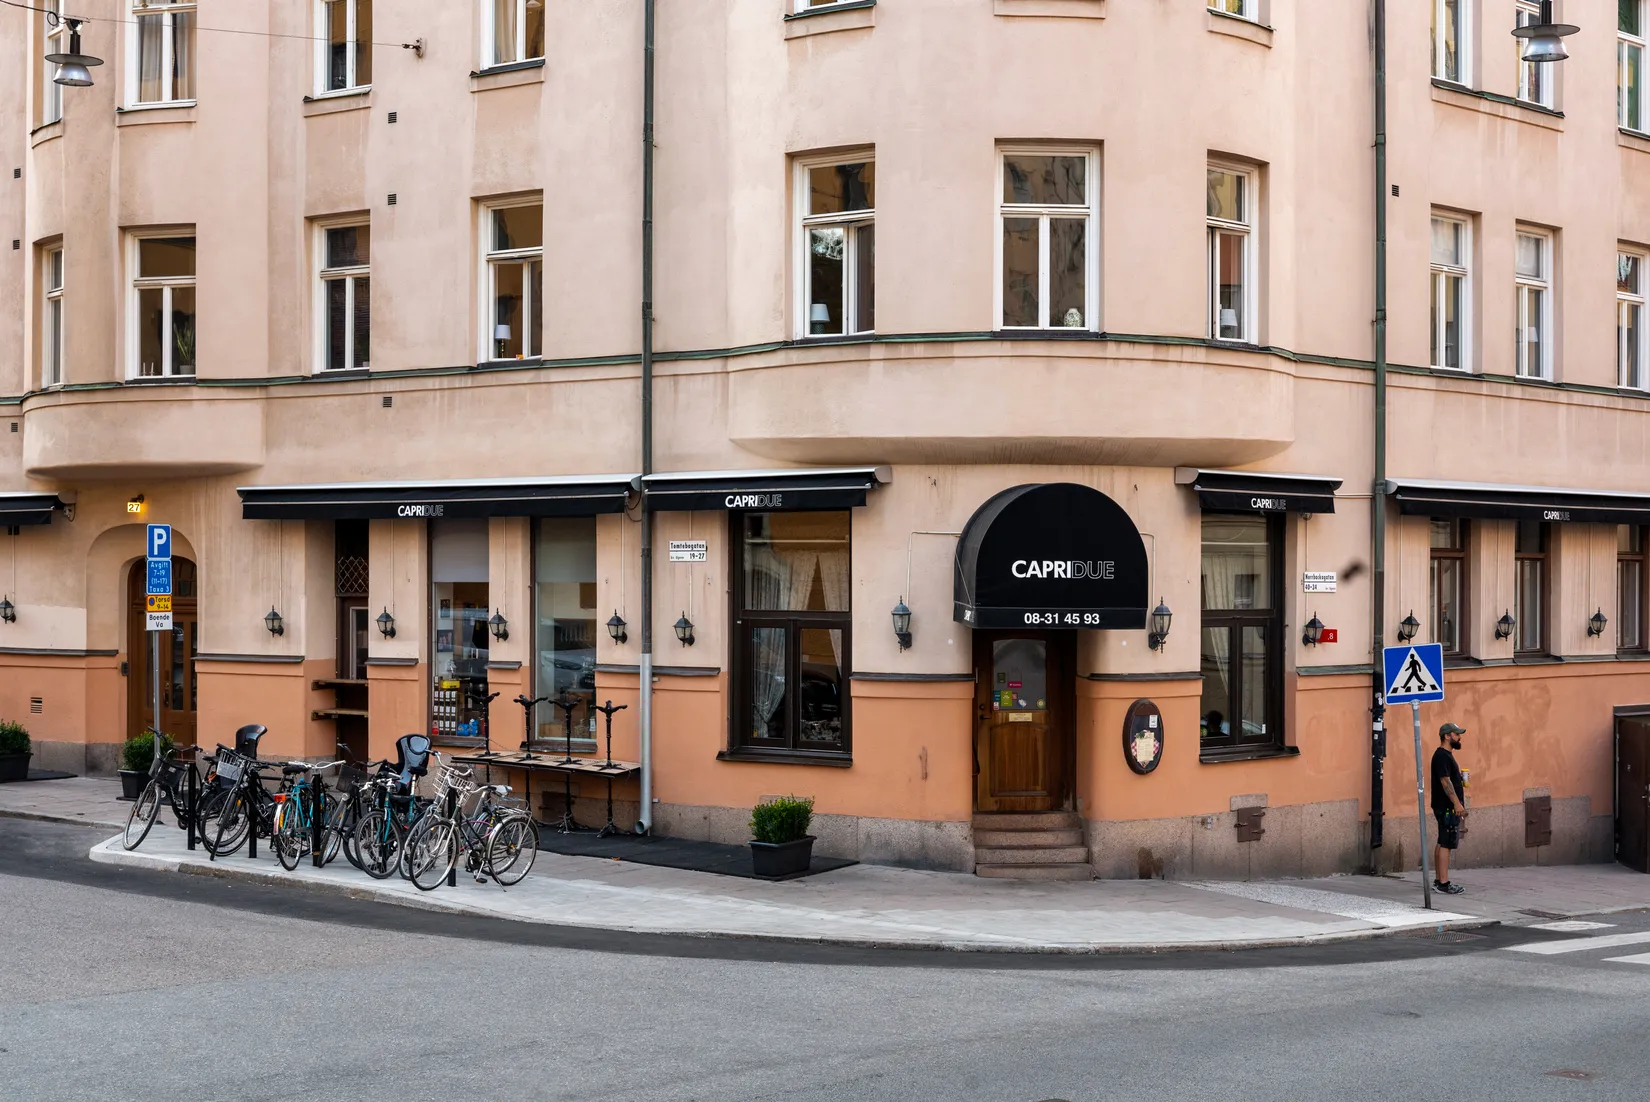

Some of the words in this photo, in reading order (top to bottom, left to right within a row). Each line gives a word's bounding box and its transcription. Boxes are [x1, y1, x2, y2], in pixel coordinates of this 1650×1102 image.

[128, 503, 140, 512] 27
[153, 528, 167, 555] P
[670, 542, 705, 551] Tomtebogatan
[689, 552, 705, 560] 19-27
[150, 561, 169, 570] Avgift
[153, 569, 166, 577] 7-19
[151, 576, 168, 585] (11-17)
[149, 585, 164, 593] Taxa
[165, 585, 170, 593] 3
[1024, 612, 1059, 625] 08-31
[1063, 612, 1080, 625] 45
[1083, 612, 1100, 625] 93
